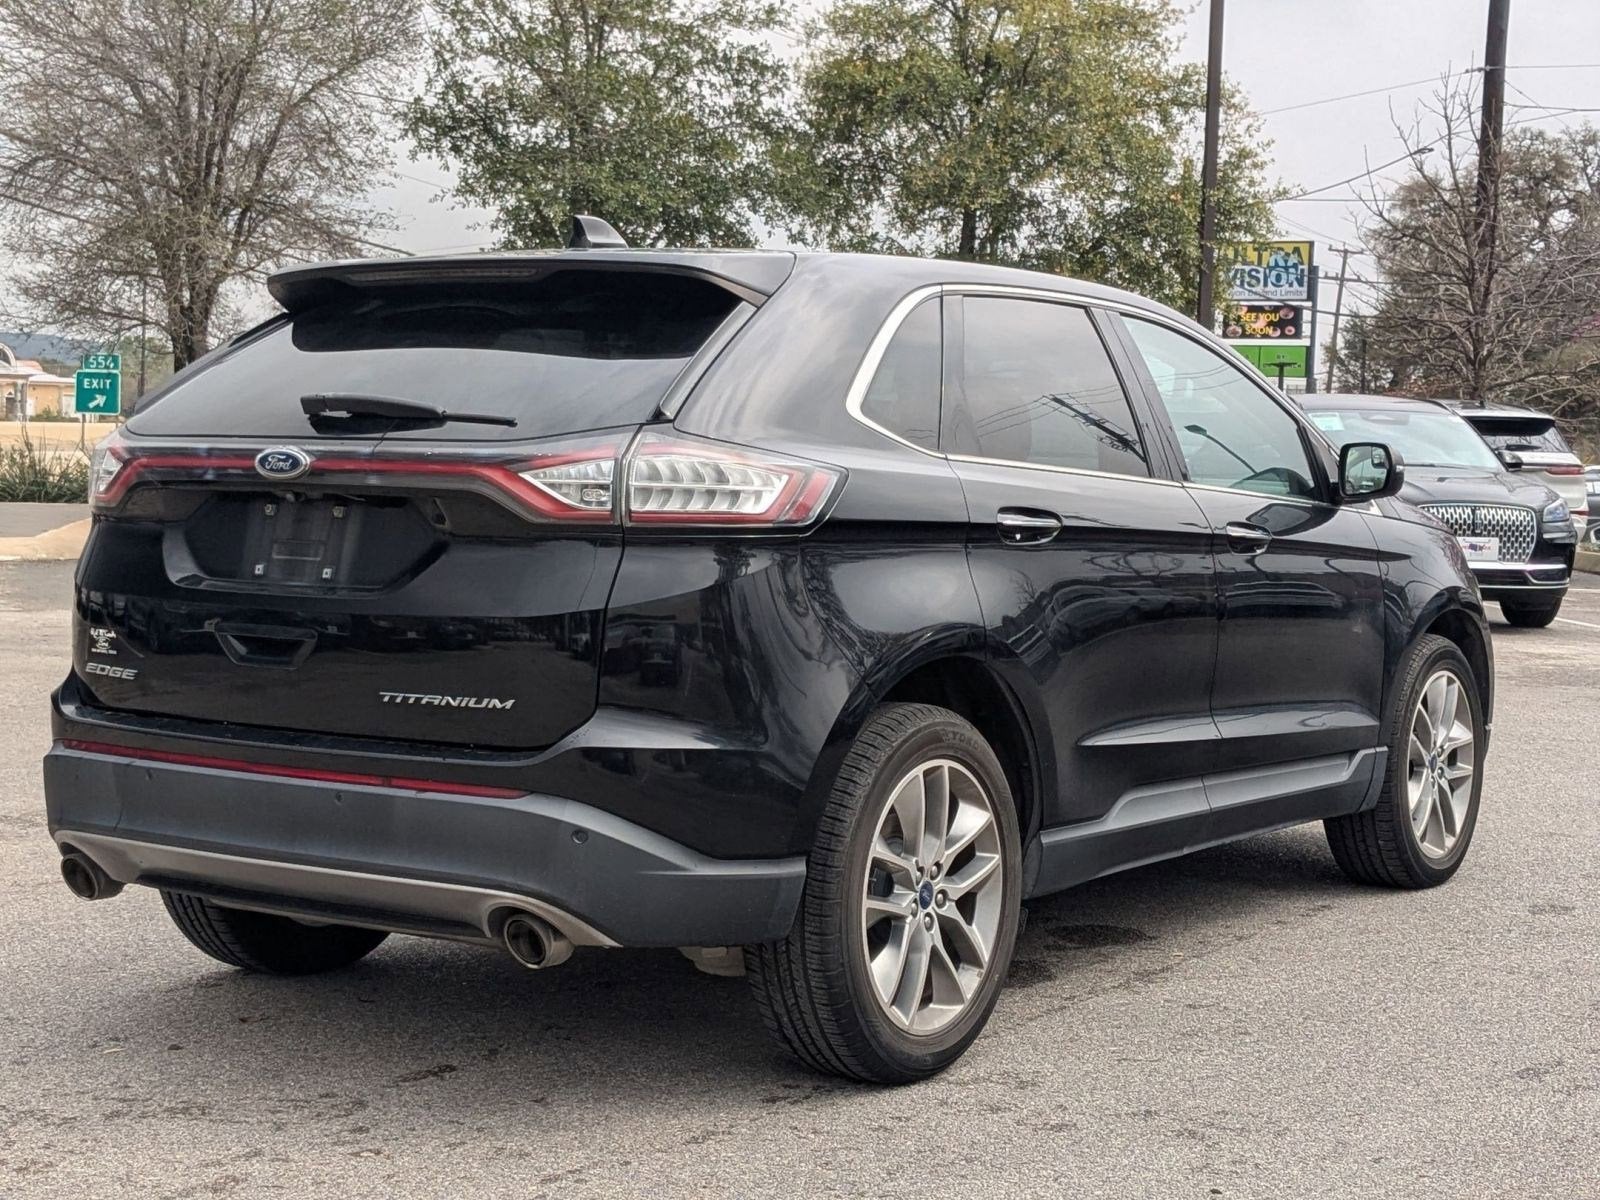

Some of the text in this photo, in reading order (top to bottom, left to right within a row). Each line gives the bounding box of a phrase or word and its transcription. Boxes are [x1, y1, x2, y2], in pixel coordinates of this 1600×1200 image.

[1241, 312, 1280, 322] SEE YOU
[1246, 326, 1274, 335] SOON
[89, 356, 115, 369] 554
[83, 378, 112, 390] EXIT
[265, 454, 293, 470] Ford
[85, 662, 139, 680] EDGE
[379, 691, 516, 710] TITANIUM
